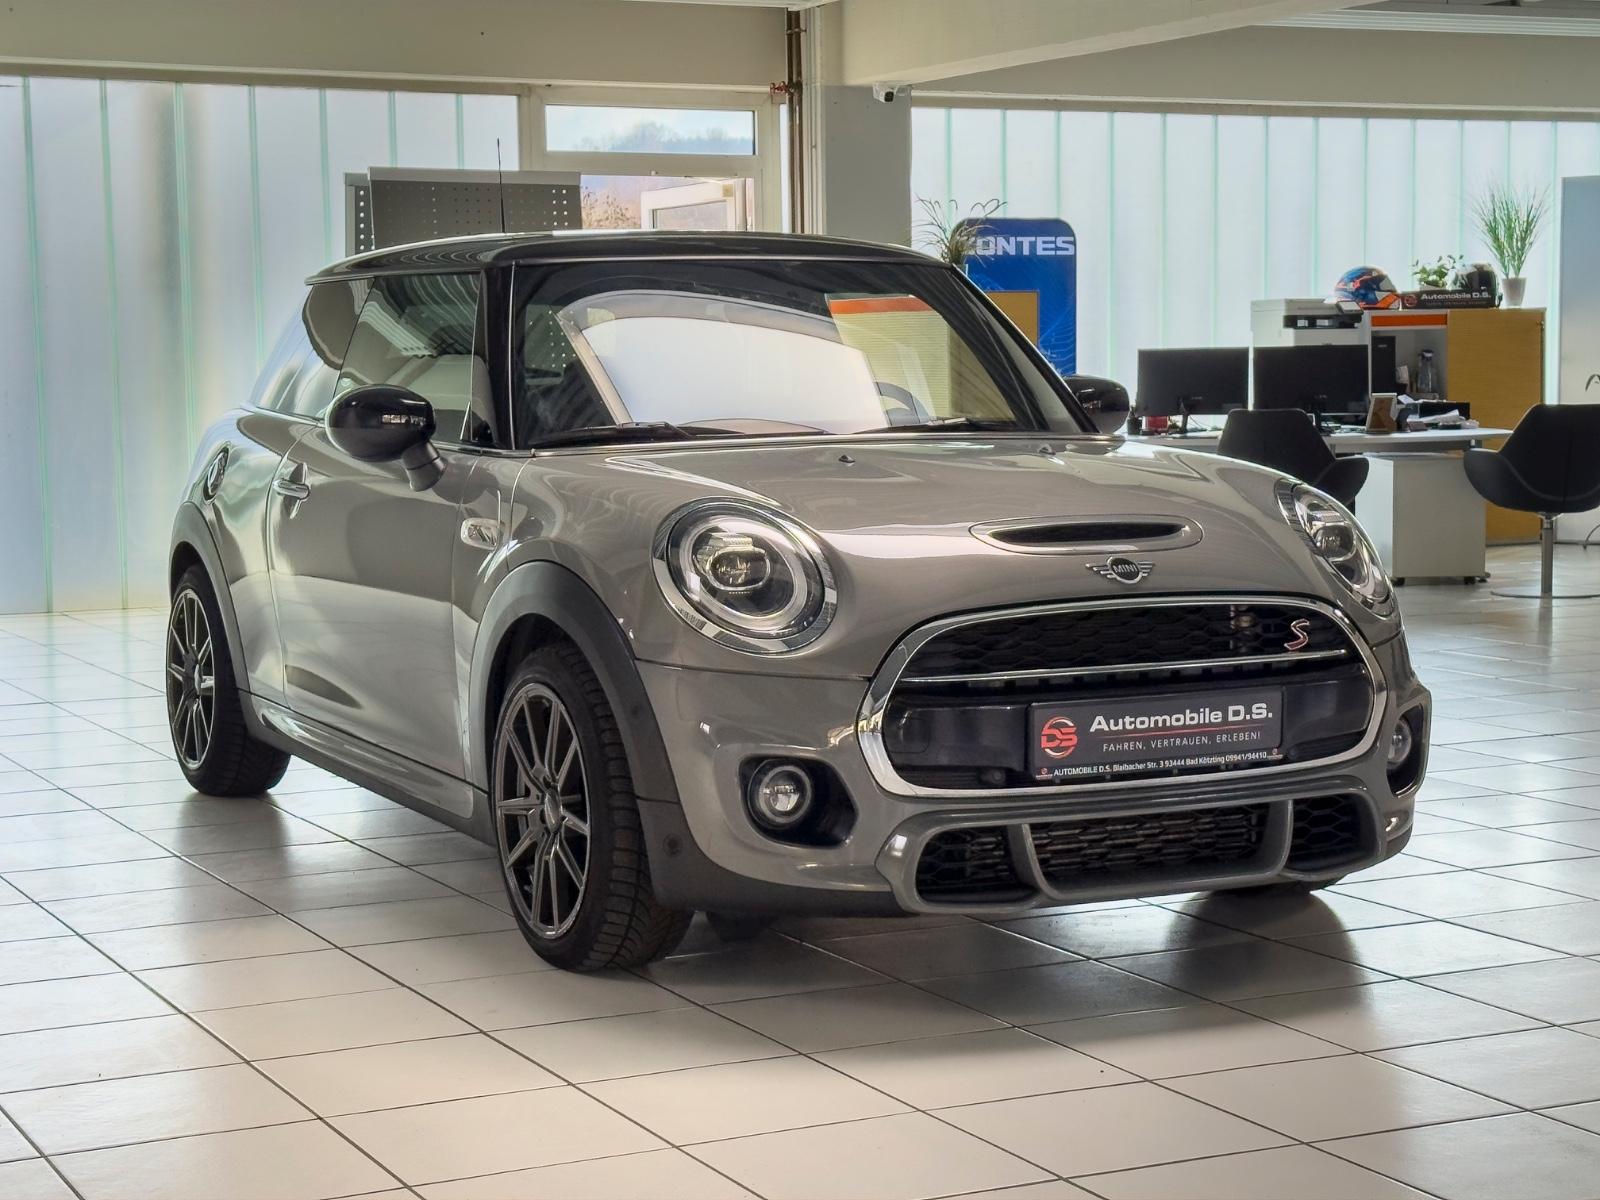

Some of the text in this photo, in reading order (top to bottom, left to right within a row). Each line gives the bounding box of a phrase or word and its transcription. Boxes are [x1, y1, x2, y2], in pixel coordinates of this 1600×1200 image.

[1420, 292, 1471, 300] Automobile
[1112, 564, 1137, 573] MINI
[1284, 618, 1310, 651] S
[1090, 702, 1273, 732] Automobile D.S.
[1150, 736, 1211, 749] VERTRAUEN,
[1054, 766, 1098, 776] AUTOMOBILE
[1099, 765, 1111, 773] D.S.
[1147, 760, 1158, 769] Str.
[1164, 758, 1185, 767] 93444
[1186, 757, 1198, 765] Bad
[1199, 754, 1225, 764] Kötzting
